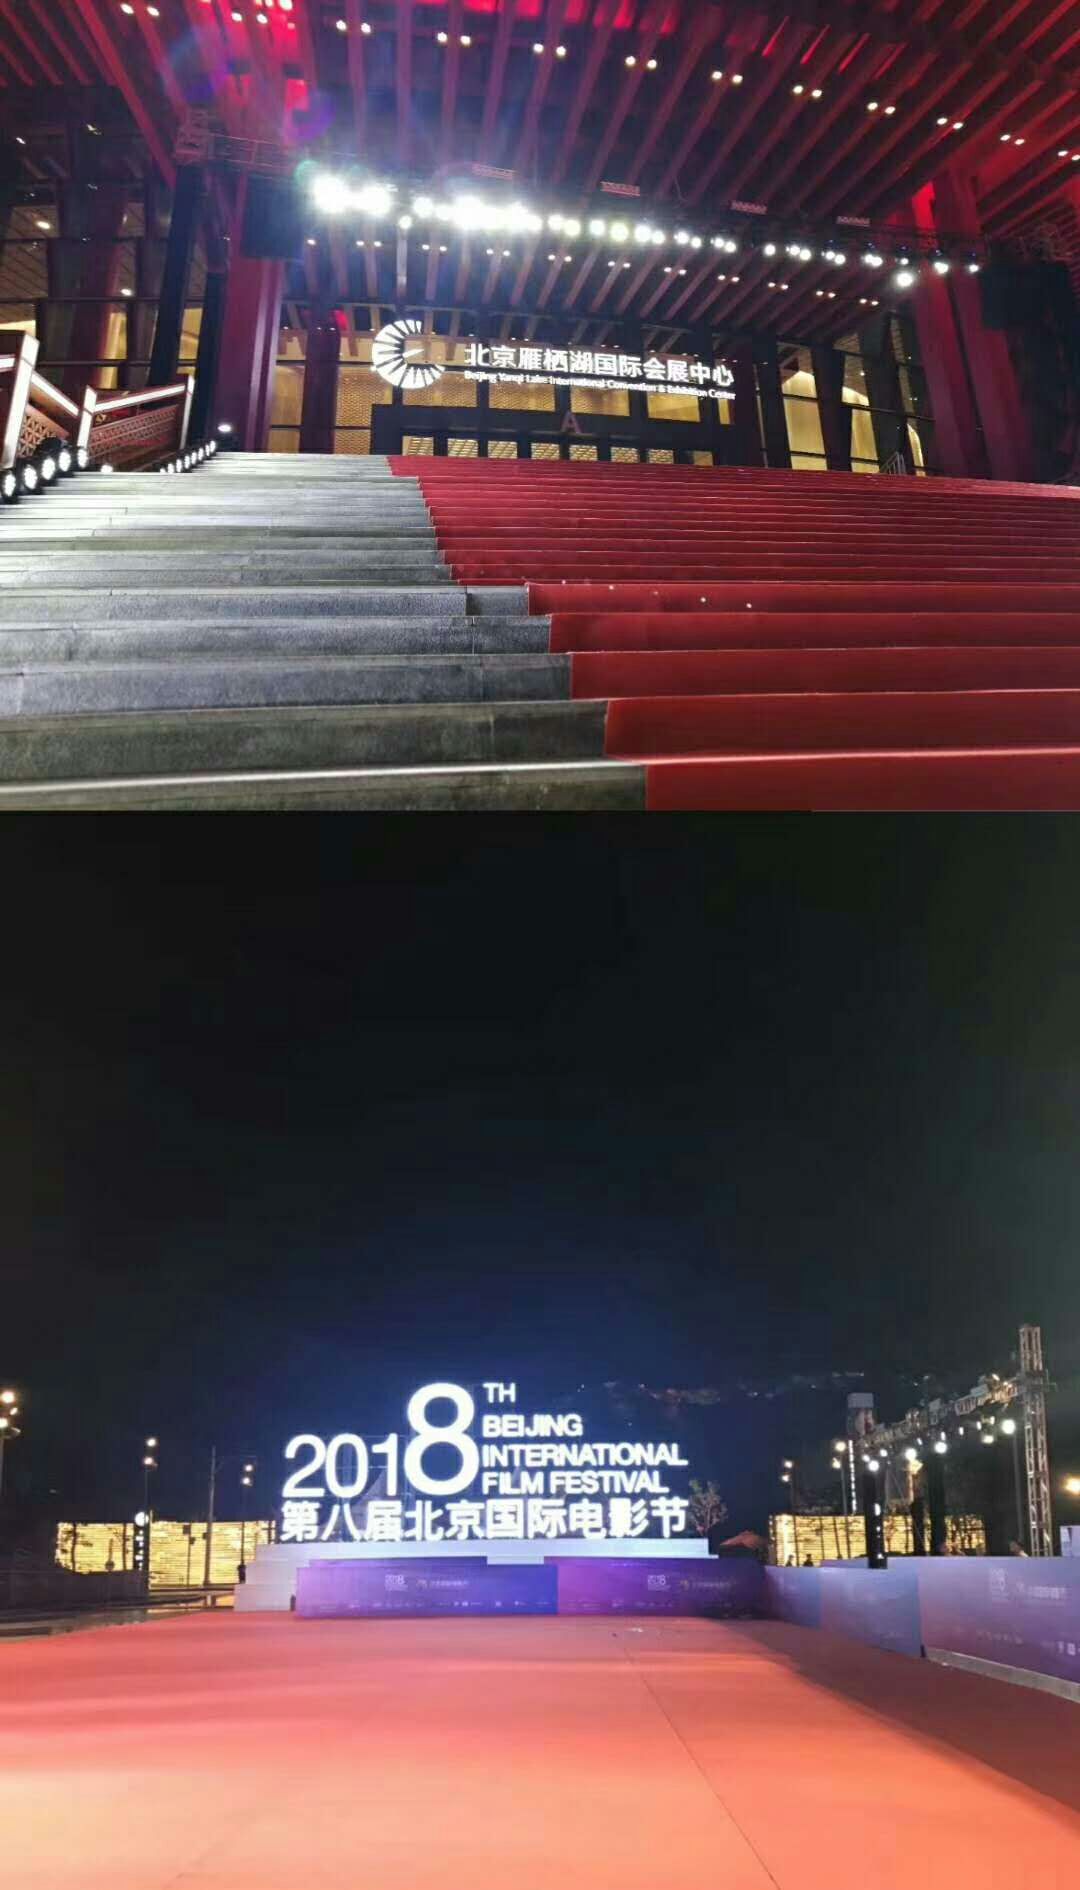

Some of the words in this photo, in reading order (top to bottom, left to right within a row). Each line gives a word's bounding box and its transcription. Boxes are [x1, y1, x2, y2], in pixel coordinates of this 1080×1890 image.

[464, 343, 735, 387] 北京雁栖湖国际会展中心
[464, 370, 497, 384] Beijing
[550, 375, 606, 390] International
[607, 379, 657, 393] Convention
[708, 388, 736, 400] Center
[560, 411, 583, 434] A
[483, 1382, 517, 1404] TH
[482, 1414, 584, 1438] BEIJING
[482, 1442, 689, 1468] INTERNATIONAL
[482, 1471, 544, 1496] FILM
[549, 1470, 670, 1495] FESTIVAL
[280, 1498, 690, 1542] 第八届北京国际电影节
